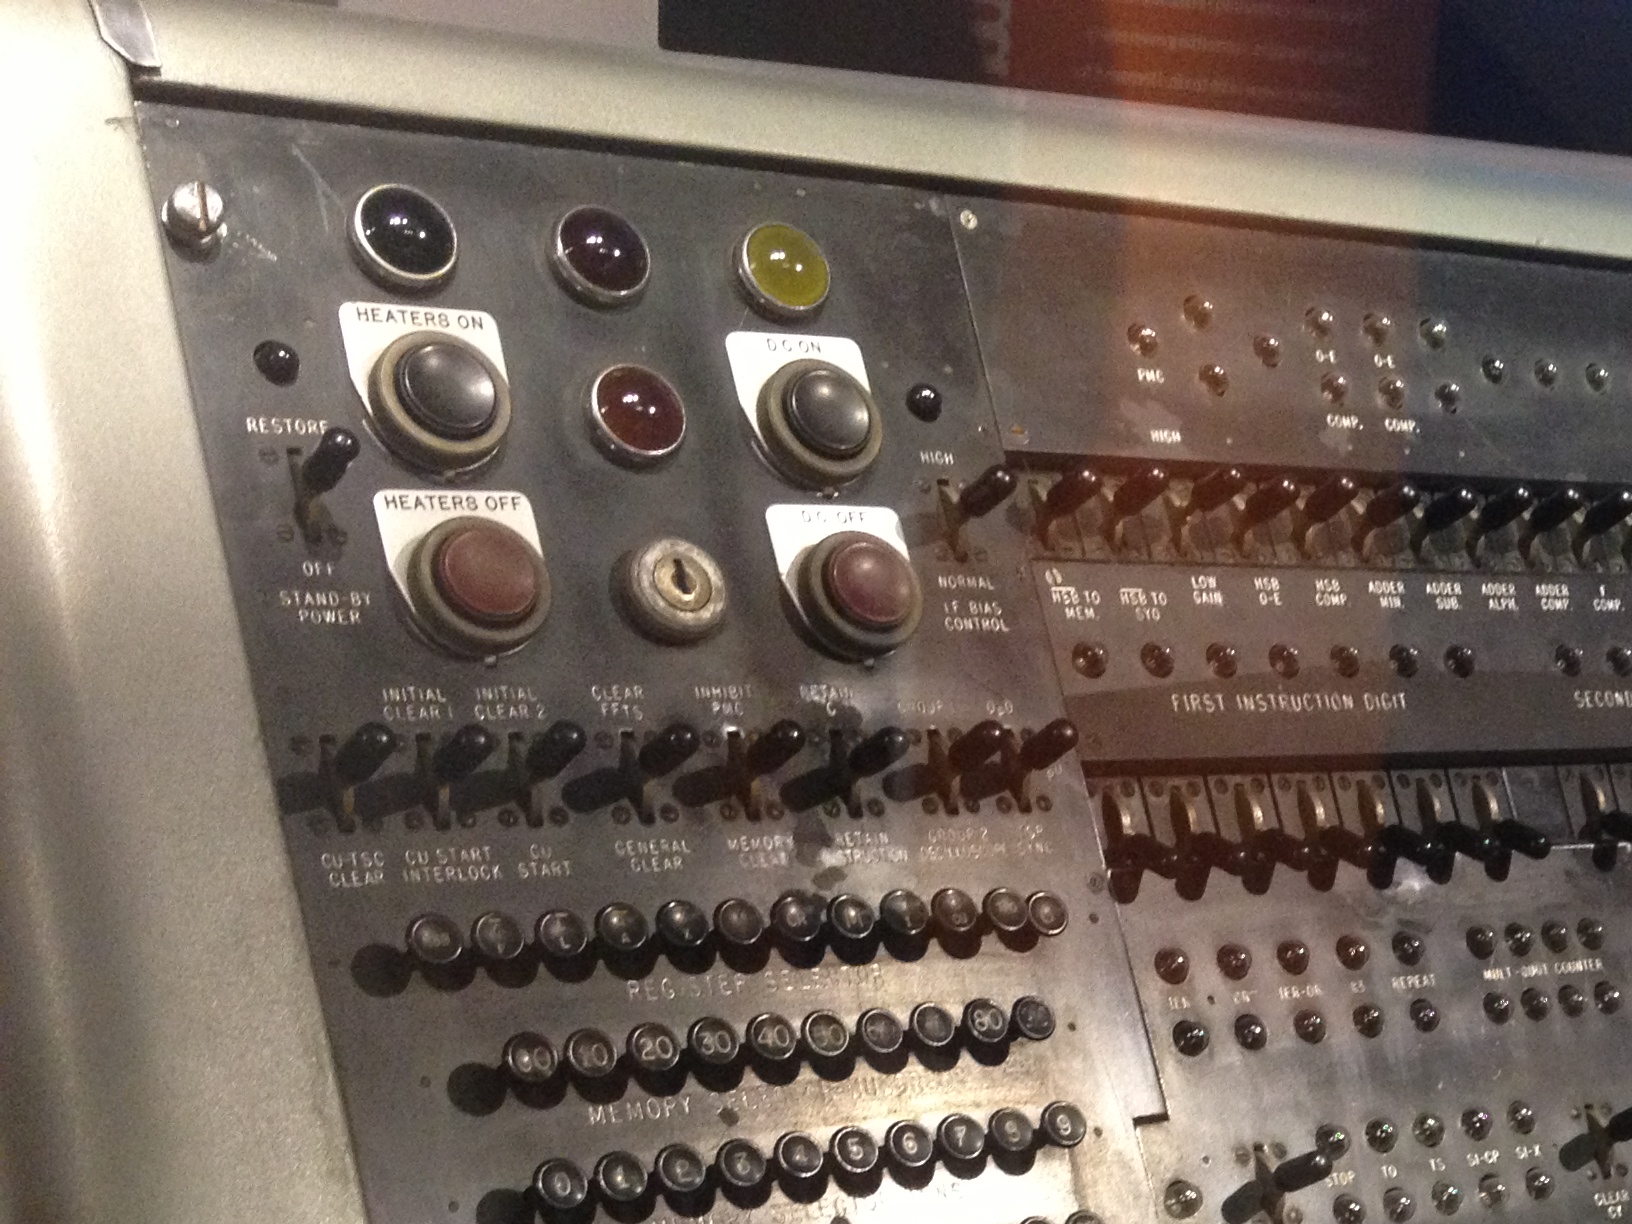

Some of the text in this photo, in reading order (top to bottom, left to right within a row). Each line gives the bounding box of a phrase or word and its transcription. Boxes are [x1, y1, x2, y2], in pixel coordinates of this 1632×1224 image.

[356, 307, 484, 331] HEATERS ON
[799, 340, 823, 354] ON
[246, 417, 329, 437] RESTORE
[1150, 428, 1181, 443] HIGH
[920, 451, 954, 465] HIGH
[383, 494, 523, 512] HEATERS OFF
[837, 511, 868, 525] OFF
[302, 561, 336, 577] OFF
[938, 575, 995, 591] NORMAL
[1191, 575, 1217, 590] LOW
[279, 590, 371, 607] STAND-BY
[1083, 590, 1101, 606] TO
[1149, 591, 1168, 606] TO
[298, 608, 361, 626] POWER
[969, 601, 1003, 616] BIAS
[944, 617, 1010, 633] CONTROL
[382, 686, 447, 703] INITIAL
[475, 686, 538, 702] INITIAL
[591, 685, 645, 702] CLEAR
[695, 684, 752, 700] INHIBIT
[1171, 692, 1407, 713] FIRST INSTRUCTION DIGIT
[383, 705, 442, 721] CLEAR
[473, 704, 548, 721] CLEAR 2
[405, 846, 492, 866] CU START
[530, 844, 552, 860] CU
[614, 839, 691, 858] GENERAL
[518, 860, 572, 879] START
[631, 856, 683, 873] CLEAR
[329, 870, 386, 888] CLEAR
[402, 865, 502, 884] INTERLOCK
[974, 1007, 1002, 1032] 80
[702, 1029, 732, 1056] 30
[757, 1023, 790, 1048] 40
[641, 1035, 673, 1061] 20
[588, 1095, 691, 1126] MEMORY
[1057, 1114, 1072, 1136] 9
[902, 1132, 918, 1154] 6
[954, 1125, 967, 1148] 7
[847, 1137, 864, 1160] 5
[675, 1158, 693, 1182] 2
